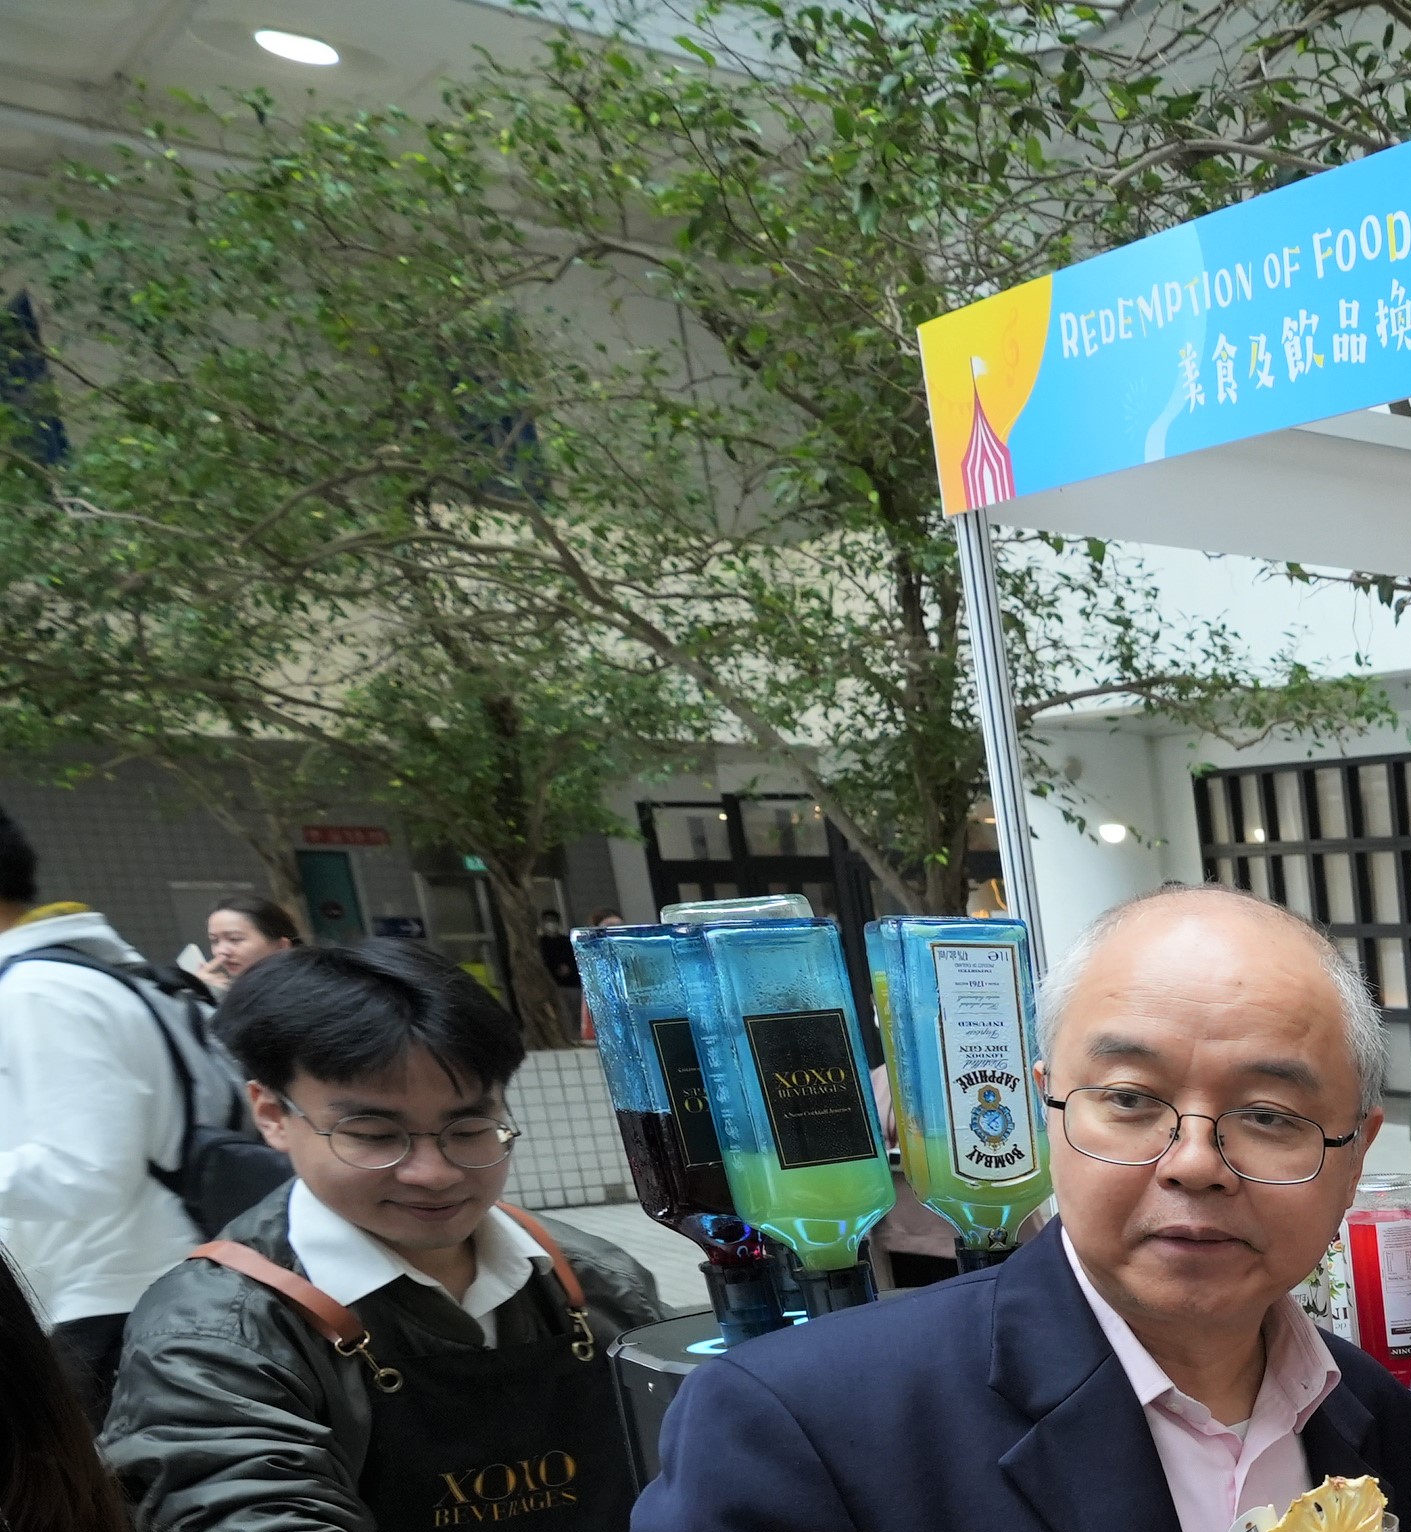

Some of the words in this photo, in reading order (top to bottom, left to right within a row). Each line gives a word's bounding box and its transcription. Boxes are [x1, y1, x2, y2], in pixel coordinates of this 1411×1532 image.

[1057, 262, 1254, 358] REDEMPTION
[1263, 247, 1302, 290] OF
[1311, 210, 1411, 281] FOOD
[774, 1066, 846, 1089] XOXO
[955, 1070, 1020, 1093] SAPPHIRE
[778, 1084, 848, 1098] BEVERAGES
[965, 1144, 1026, 1168] BOMBAY
[432, 1450, 577, 1509] XOXO
[433, 1488, 577, 1527] BEVERAGES
